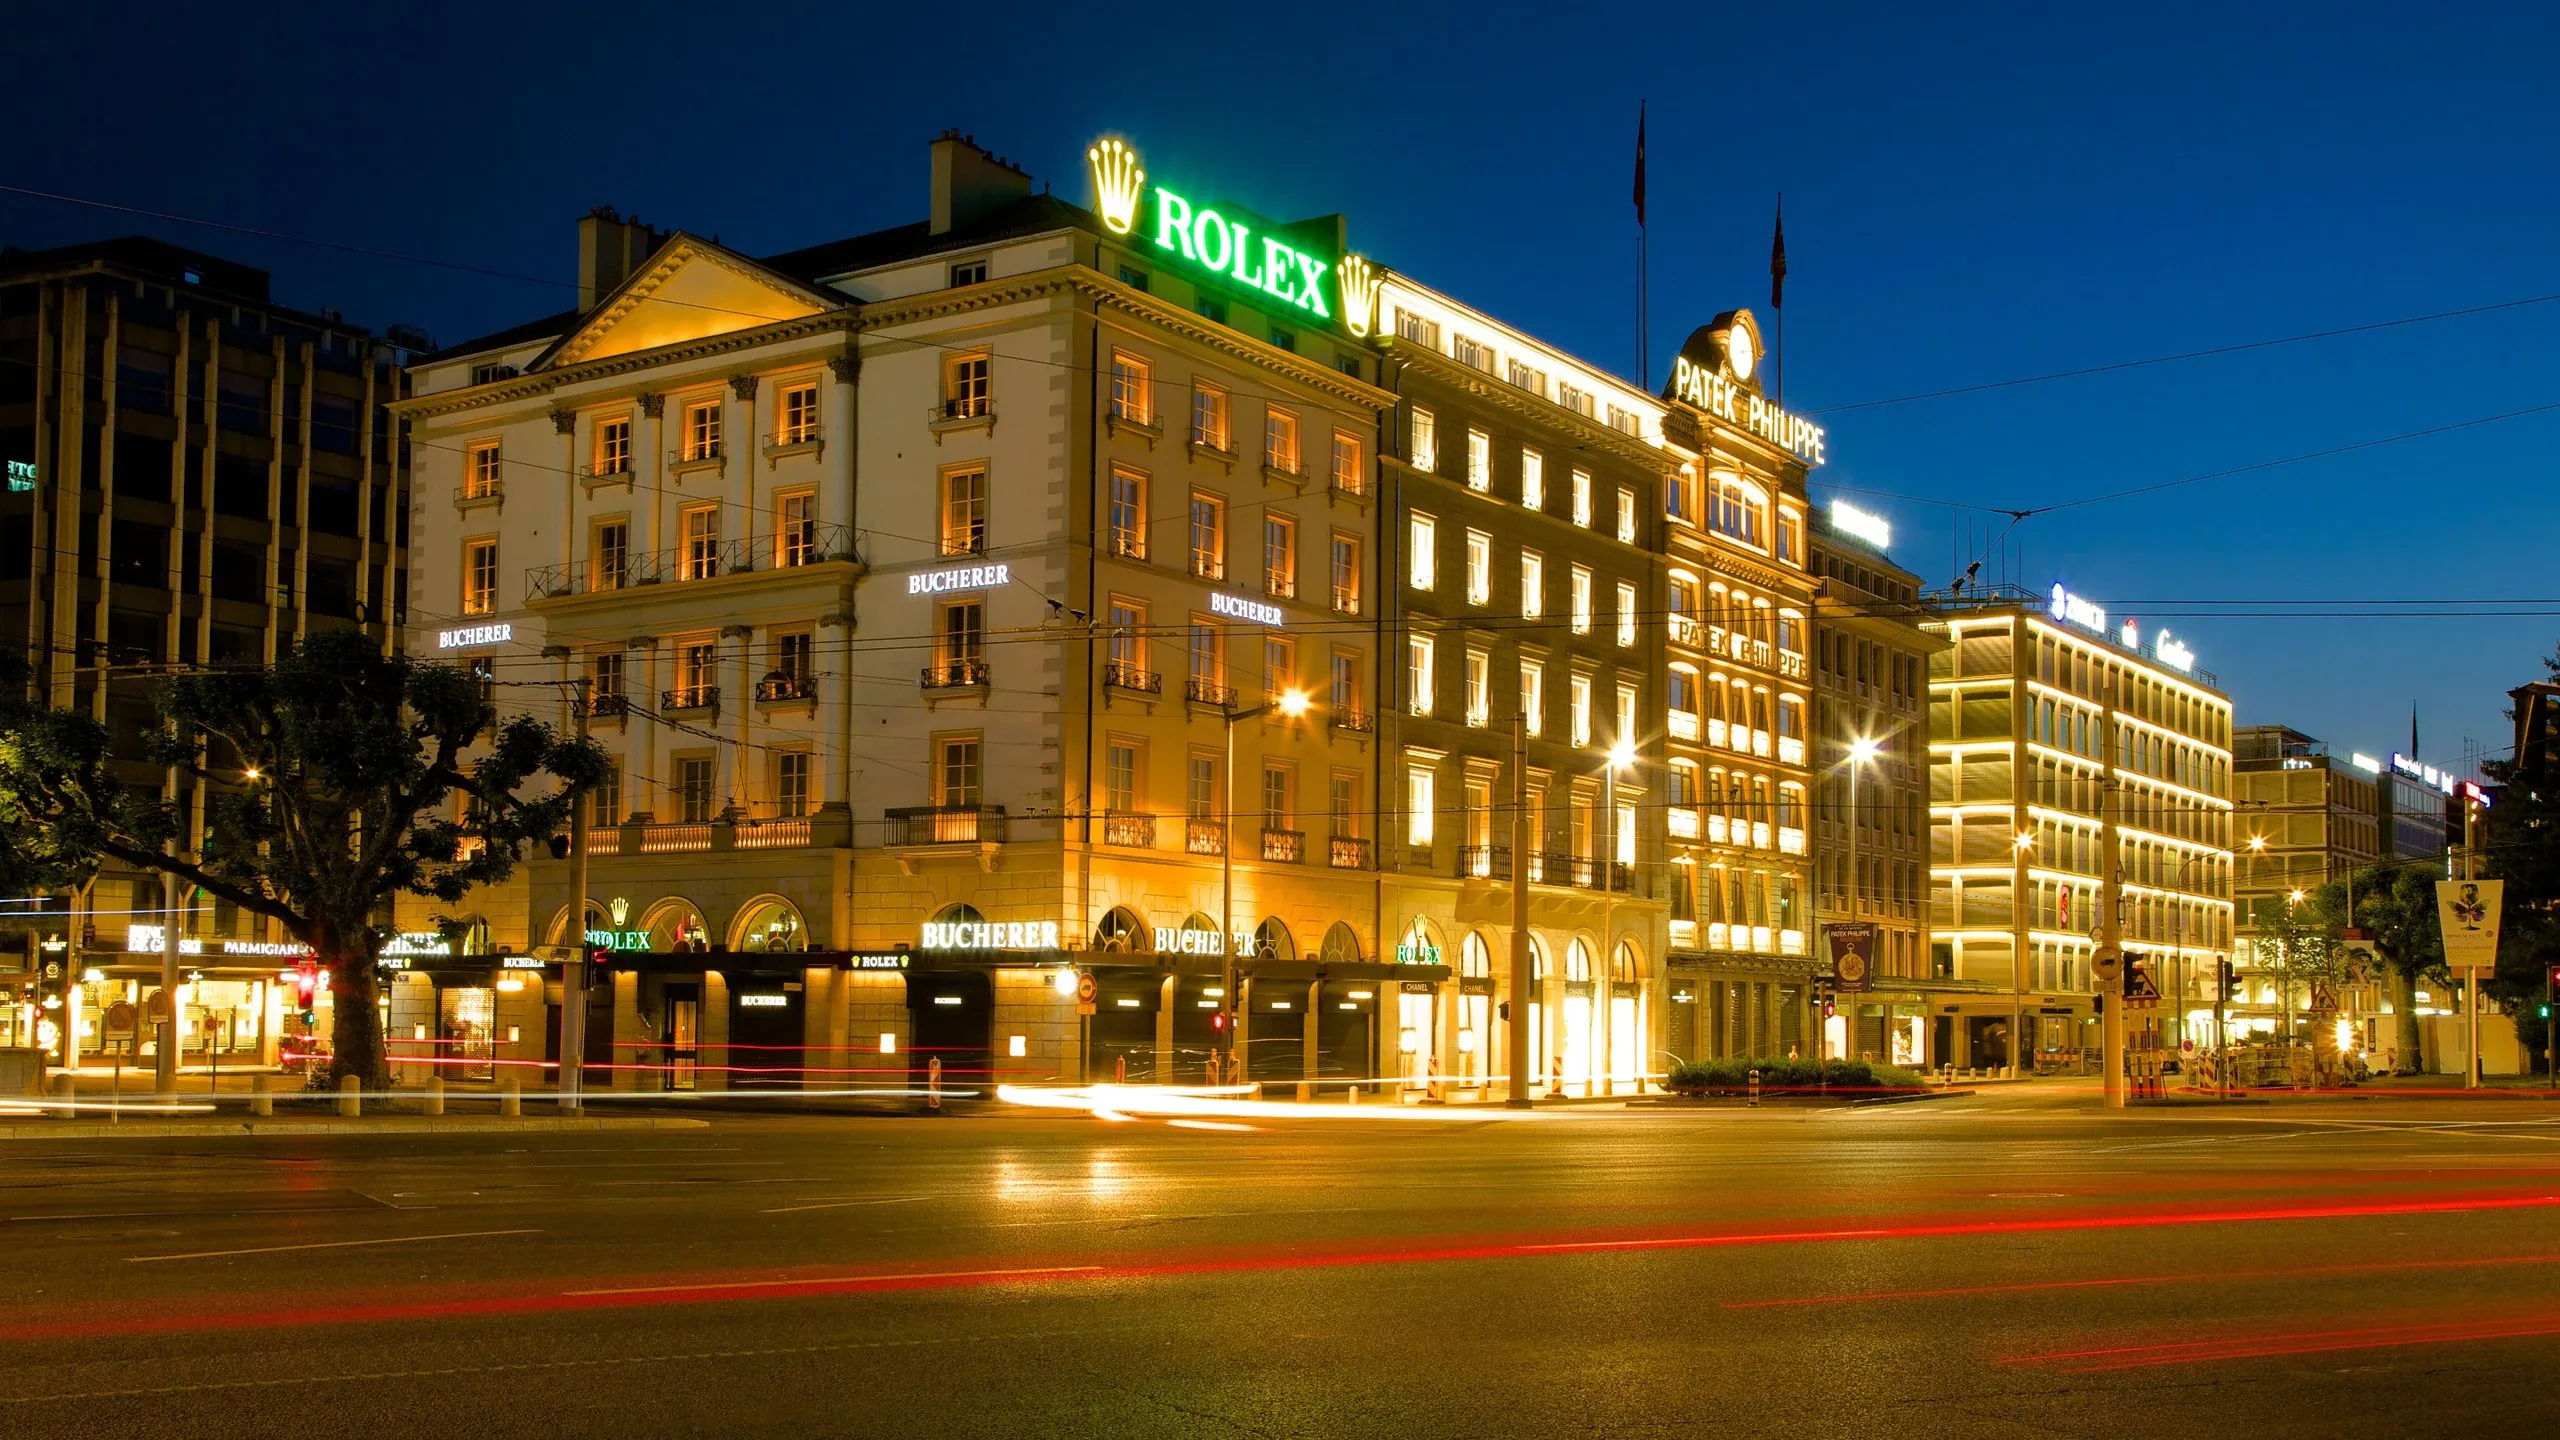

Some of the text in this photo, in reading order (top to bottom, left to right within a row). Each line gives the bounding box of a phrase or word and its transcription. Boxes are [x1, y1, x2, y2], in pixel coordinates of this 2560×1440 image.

[1155, 187, 1329, 317] ROLEX
[1677, 356, 1825, 465] PATEK PHILIPPE
[909, 564, 1010, 594] BUCHERER
[1211, 592, 1282, 626] BUCHERER
[439, 624, 512, 648] BUCHERER
[922, 922, 1058, 948] BUCHERER
[1154, 927, 1255, 957] BUCHEER
[224, 941, 298, 955] PARMIGIAN
[1396, 943, 1441, 964] ROLEX
[503, 957, 545, 967] BUCHERER
[862, 956, 898, 967] ROLEX
[1405, 983, 1428, 992] CHANEL
[1464, 985, 1485, 993] CHANEL
[1568, 988, 1586, 996] CHANEL
[1615, 989, 1632, 997] CHANEL
[741, 995, 787, 1006] BUCHERER
